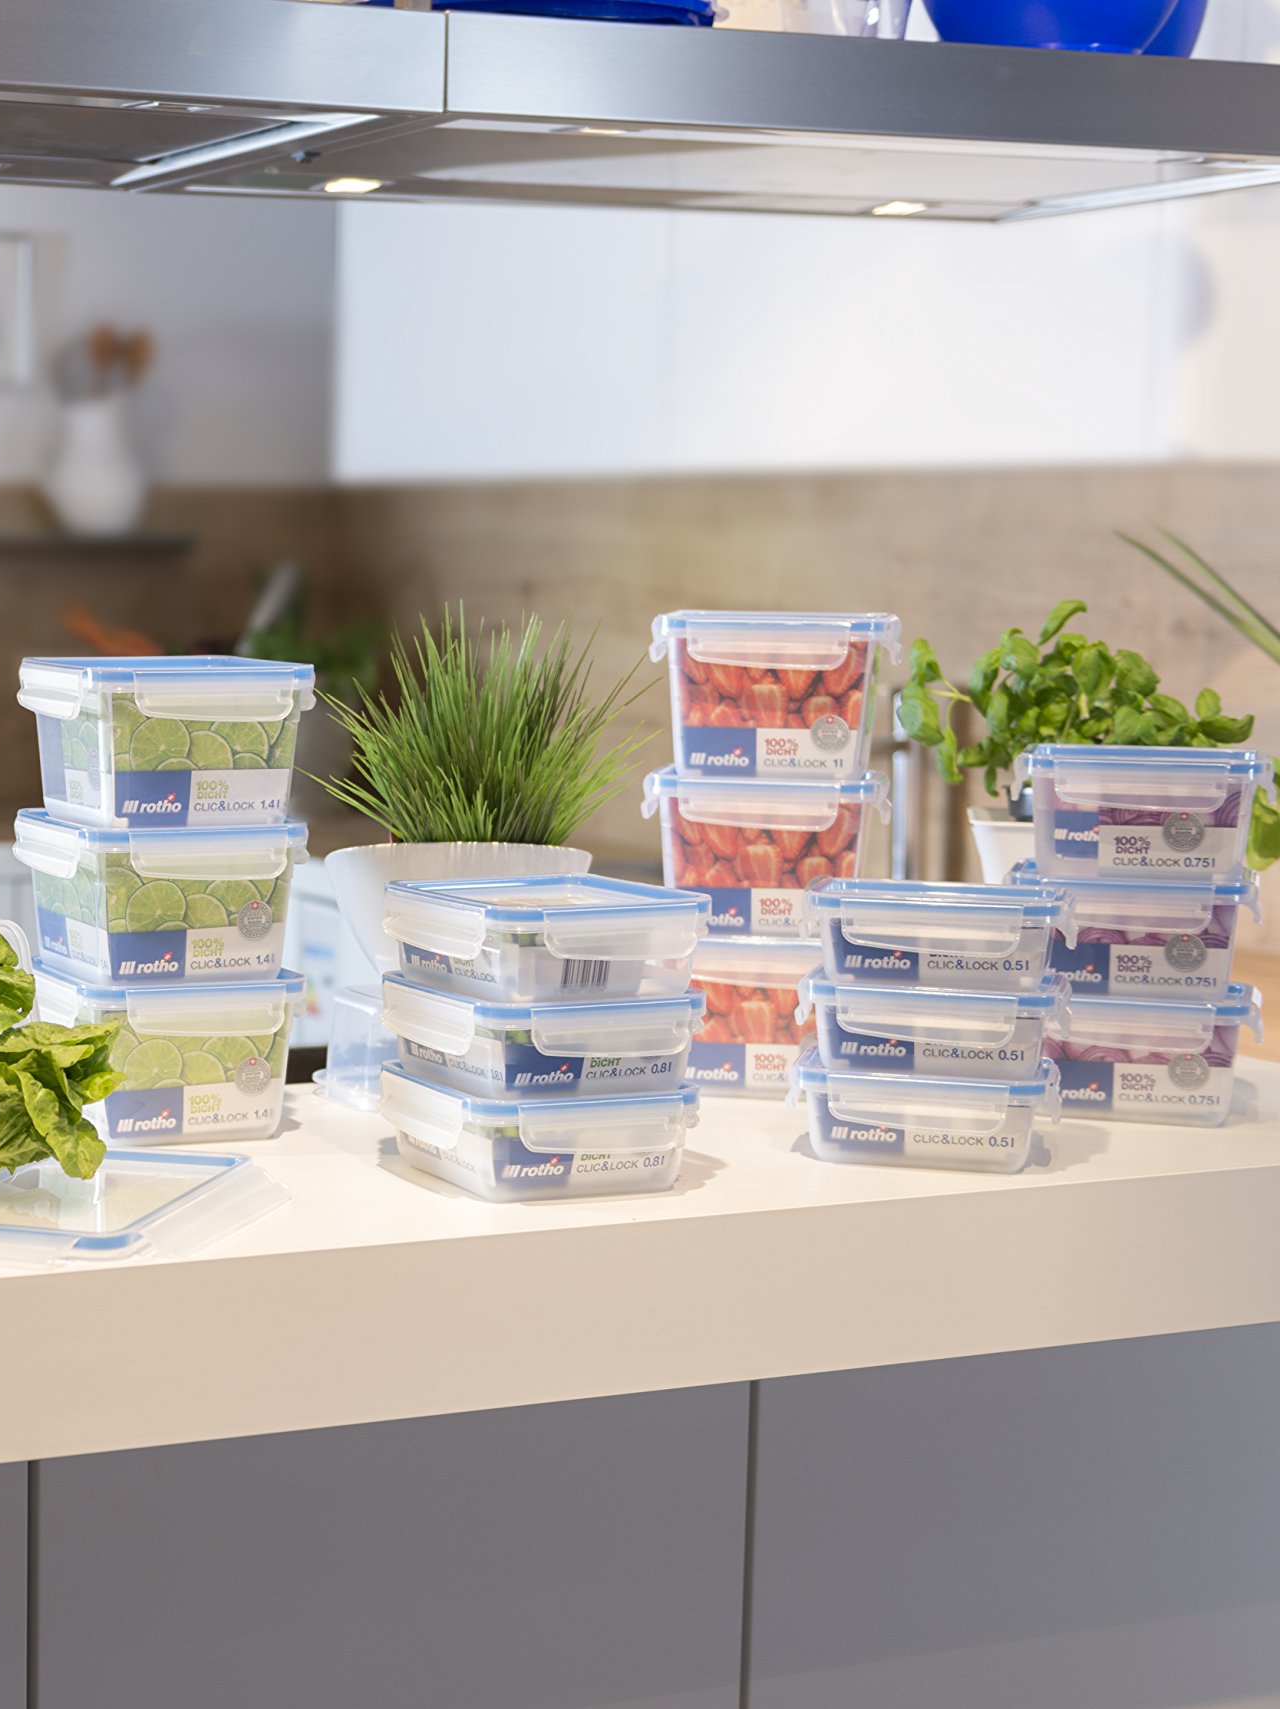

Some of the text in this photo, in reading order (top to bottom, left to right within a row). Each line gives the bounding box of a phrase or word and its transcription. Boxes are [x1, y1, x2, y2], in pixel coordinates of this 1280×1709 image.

[764, 738, 799, 749] 100%
[766, 748, 798, 756] DICHT
[707, 753, 749, 767] rotho
[764, 757, 827, 768] CLIC&LOCK
[195, 780, 229, 791] 100%
[197, 790, 228, 799] DICHT
[141, 799, 182, 813] rotho
[194, 798, 255, 811] CLIC&LOCK
[1067, 830, 1100, 842] roth
[1114, 836, 1150, 847] 100%
[1116, 846, 1150, 855] DICHT
[1113, 856, 1181, 867] CLIC&LOCK
[759, 898, 793, 908] 100%
[708, 913, 744, 927] otho
[191, 938, 224, 949] 100%
[193, 948, 223, 957] DICHT
[137, 958, 178, 973] rotho
[190, 957, 251, 970] CLIC&LOCK
[864, 956, 911, 969] rotho
[927, 959, 999, 971] CLIC&LOCK
[1116, 955, 1152, 966] 100%
[1117, 964, 1151, 973] DICHT
[1115, 975, 1183, 986] CLIC&LOCK
[419, 1047, 443, 1063] rotho
[859, 1043, 906, 1057] rotho
[922, 1048, 993, 1060] CLIC&LOCK
[590, 1057, 622, 1068] DICHT
[754, 1054, 787, 1064] 100%
[533, 1068, 574, 1083] rotho
[696, 1067, 739, 1081] rotho
[1120, 1073, 1156, 1084] 100%
[1121, 1083, 1155, 1091] DICHT
[189, 1093, 222, 1106] 100%
[1062, 1086, 1106, 1101] rotho
[1119, 1093, 1186, 1104] CLIC&LOCK
[190, 1104, 221, 1113] DICHT
[135, 1114, 176, 1131] rotho
[188, 1112, 248, 1126] CLIC&LOCK
[850, 1127, 896, 1142] rotho
[913, 1134, 983, 1146] CLIC&LOCK
[522, 1163, 564, 1177] rotho
[577, 1161, 639, 1174] CLIC&LOCK
